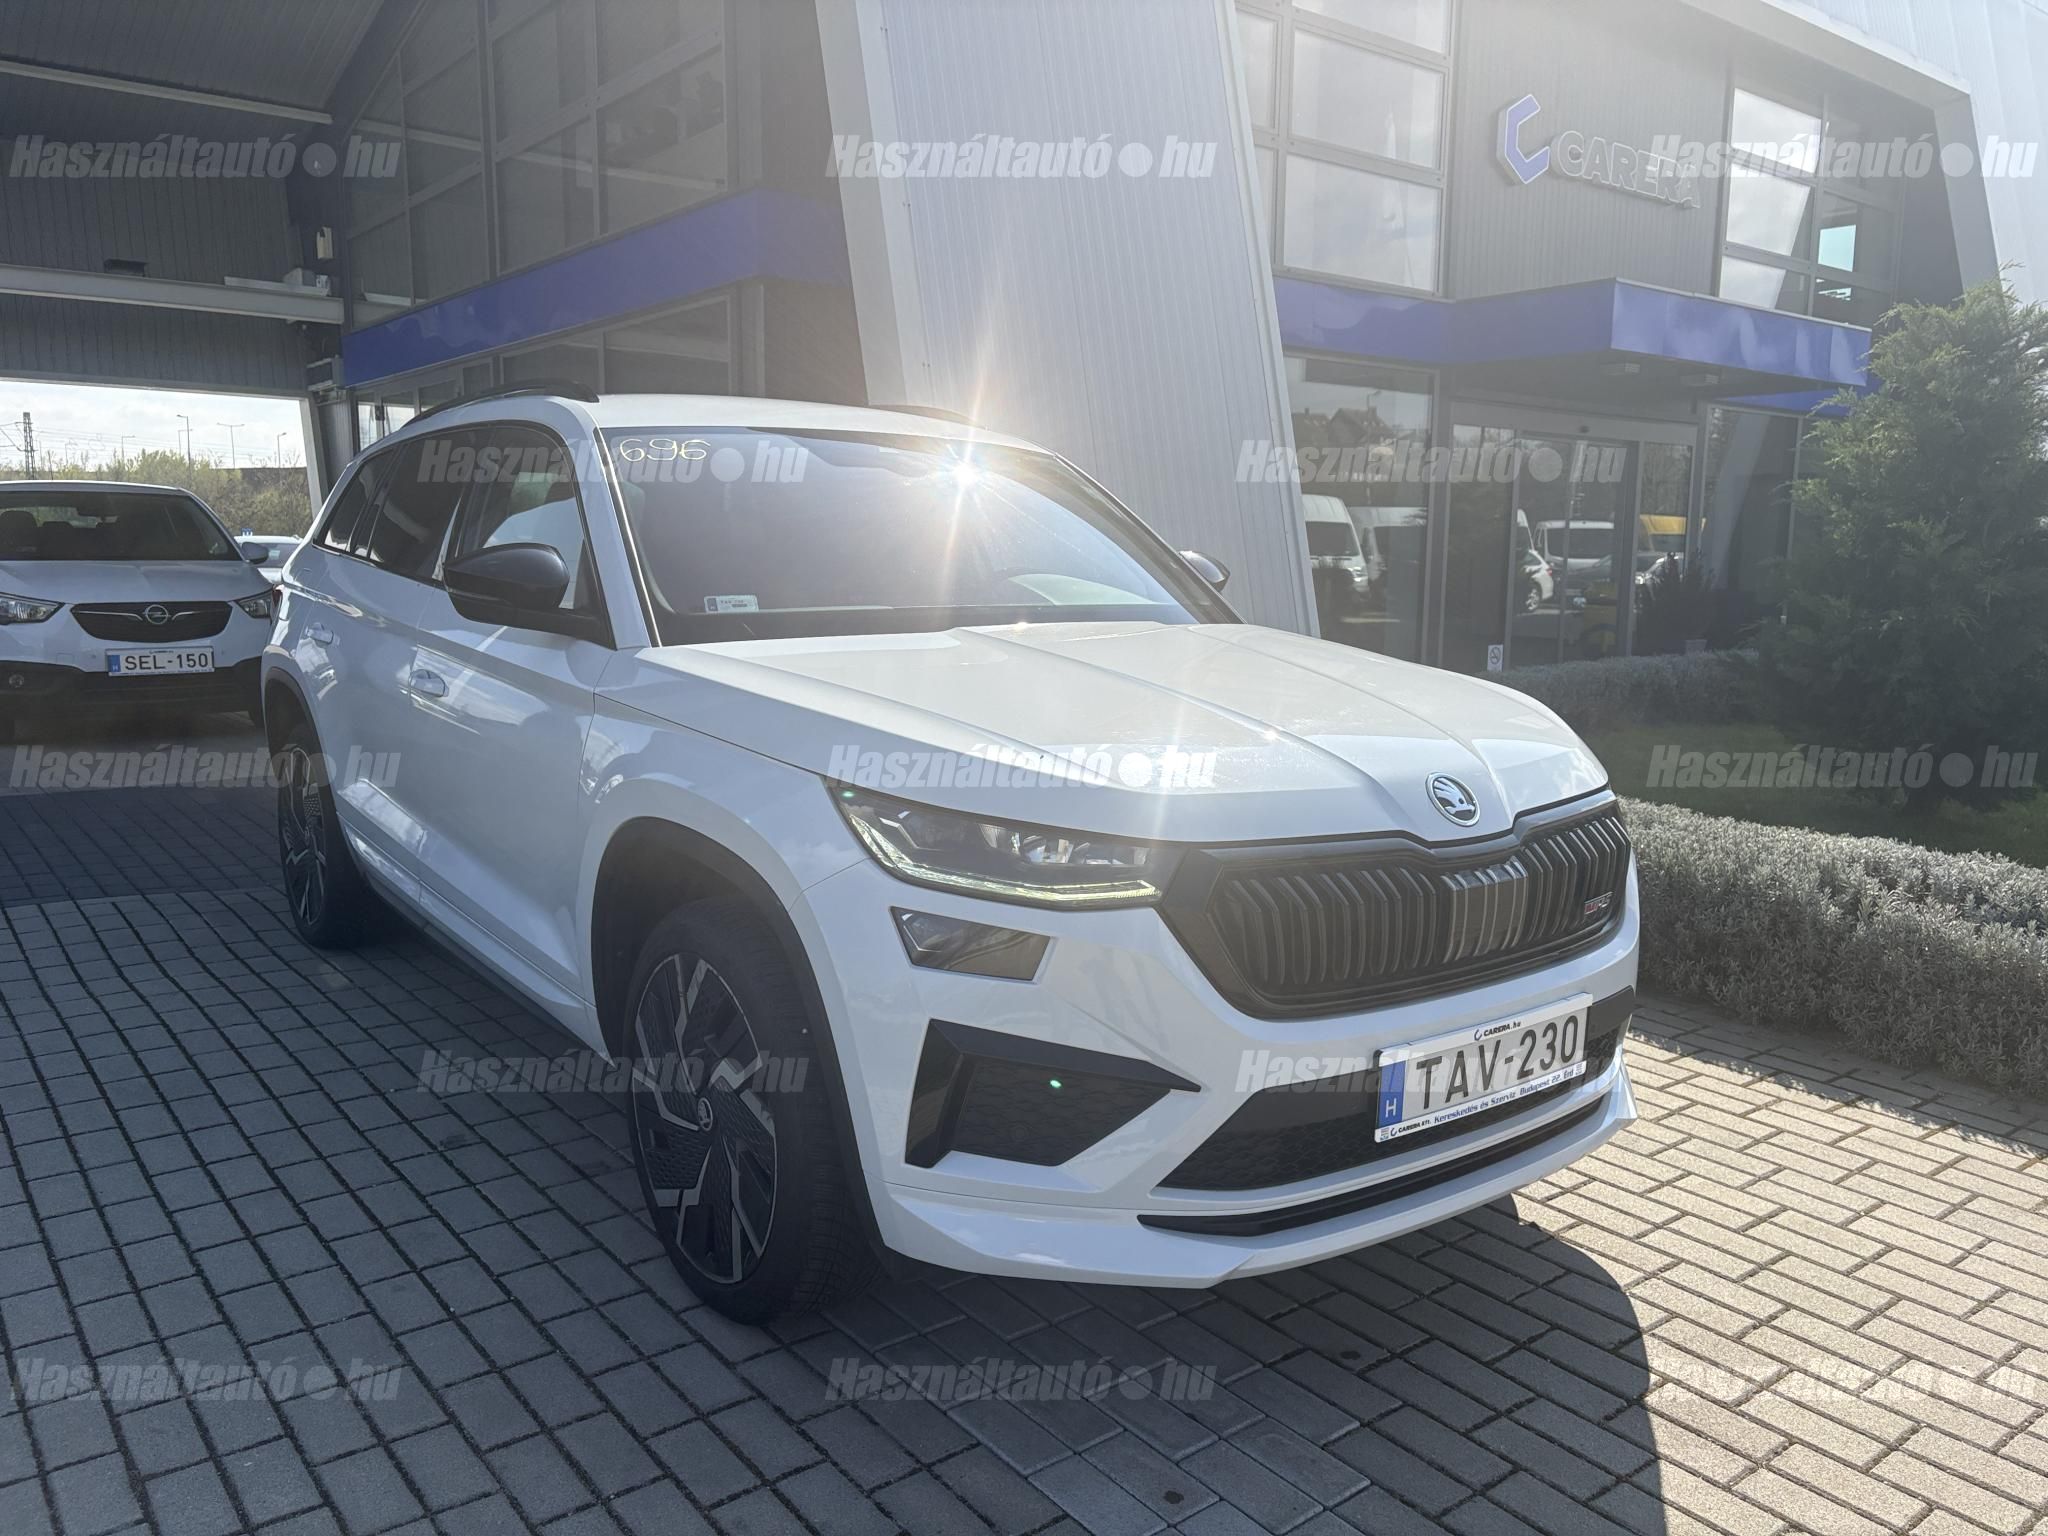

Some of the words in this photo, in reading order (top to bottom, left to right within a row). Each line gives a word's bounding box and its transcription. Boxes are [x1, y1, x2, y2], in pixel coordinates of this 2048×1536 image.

[620, 438, 711, 461] 696
[125, 653, 208, 670] SEL-150
[1416, 1015, 1579, 1110] TAV-230
[1519, 1079, 1550, 1096] Budapest
[1385, 1097, 1397, 1118] H
